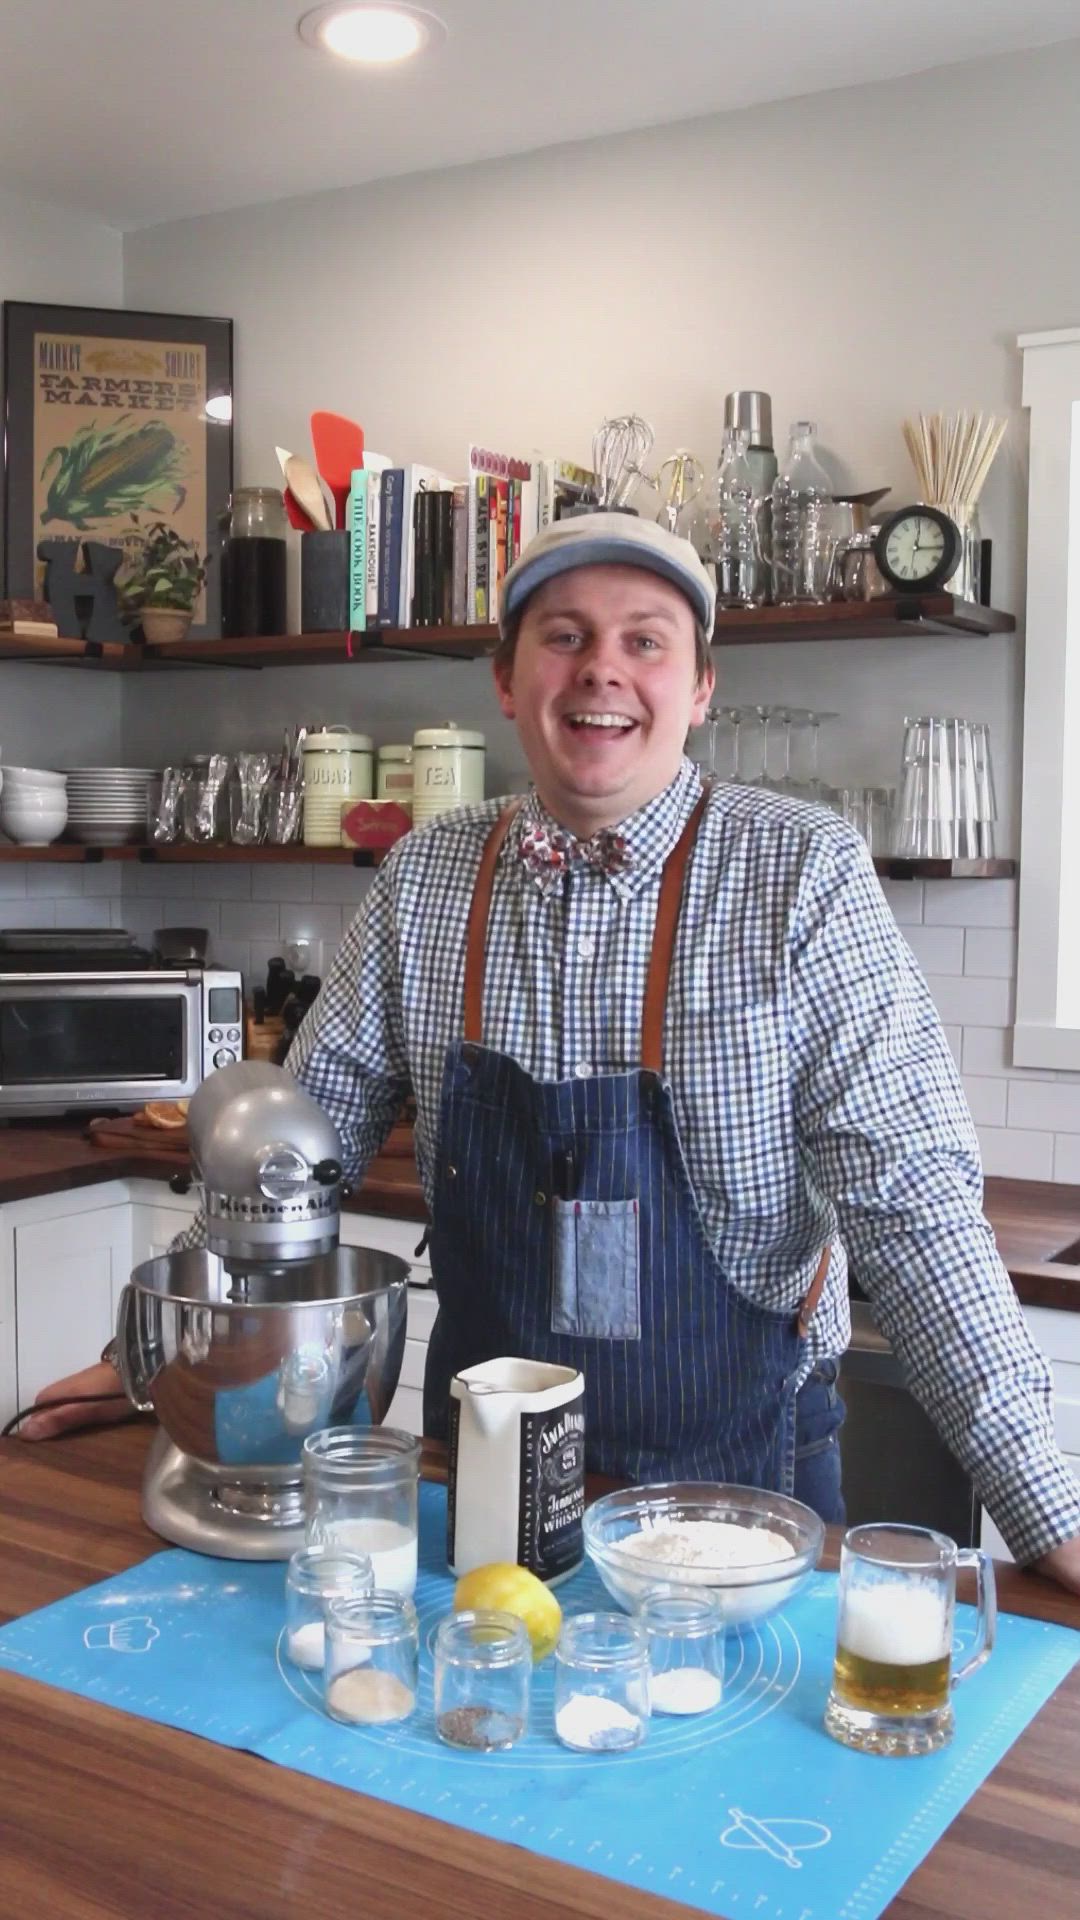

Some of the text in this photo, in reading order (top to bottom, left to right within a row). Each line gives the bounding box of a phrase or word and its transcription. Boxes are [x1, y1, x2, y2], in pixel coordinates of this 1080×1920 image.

[40, 341, 82, 372] MARKET
[44, 389, 202, 412] MARKET
[352, 496, 363, 611] THE COOK BOOK
[367, 524, 376, 583] BAKEHOUSE
[424, 767, 456, 786] TEA
[524, 1494, 532, 1563] TENNESSE
